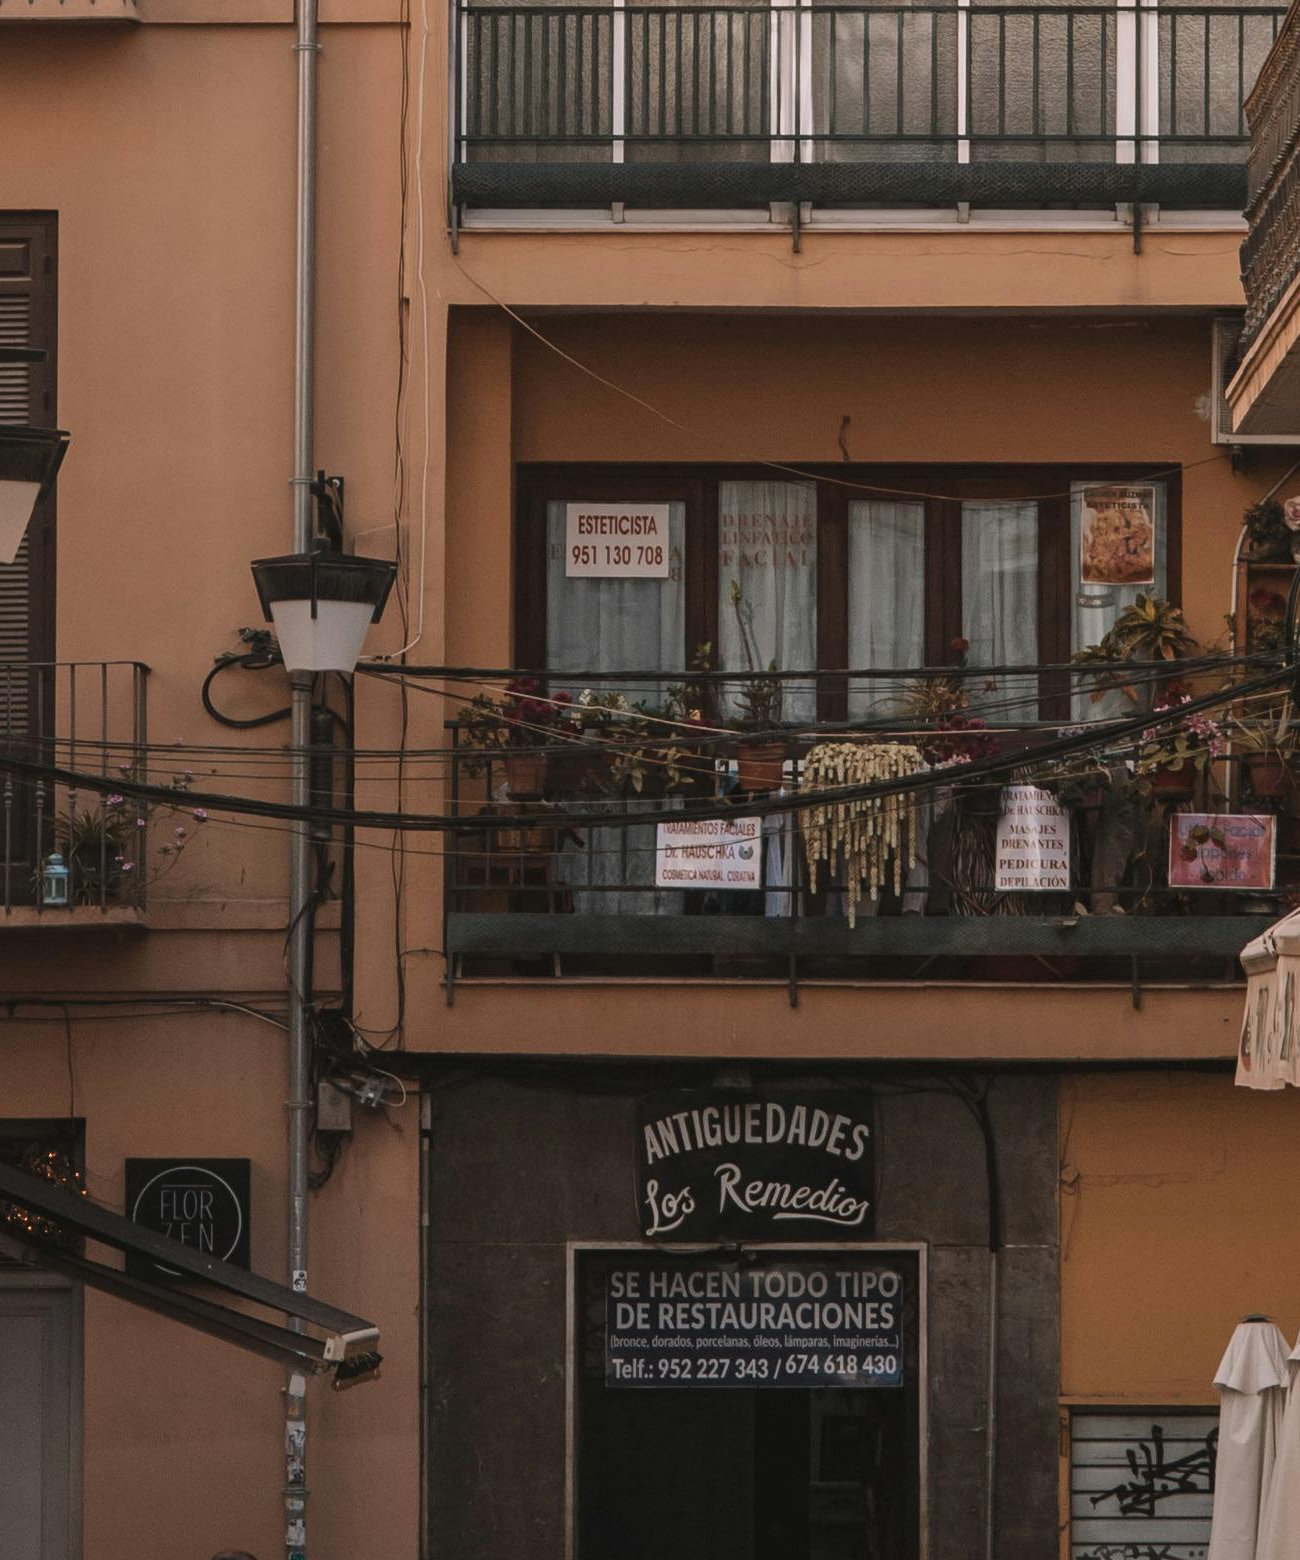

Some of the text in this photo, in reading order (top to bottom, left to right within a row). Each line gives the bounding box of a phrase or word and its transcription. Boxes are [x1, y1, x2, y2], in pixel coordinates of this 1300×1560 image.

[578, 514, 657, 535] ESTETICISTA
[572, 545, 597, 565] 951
[605, 545, 631, 565] 130
[637, 545, 663, 565] 708
[721, 549, 814, 567] FACIAL
[1010, 825, 1056, 835] MASAJES
[1002, 839, 1064, 849] DRENANTES
[999, 858, 1067, 870] PEDICURA
[1000, 874, 1067, 887] DEPILACIÓN
[643, 1103, 869, 1165] ANTIGUEDADES
[160, 1189, 214, 1220] FLOR
[644, 1162, 870, 1237] Los Remedios
[611, 1271, 899, 1299] SE HACEN TODO TIPO
[616, 1303, 894, 1329] DE RESTAURACIONES
[652, 1334, 693, 1349] dorados,
[612, 1359, 653, 1379] Telf.:
[659, 1359, 692, 1379] 952
[697, 1359, 729, 1379] 227
[735, 1359, 769, 1379] 343
[785, 1355, 819, 1375] 674
[824, 1355, 858, 1375] 618
[863, 1355, 897, 1375] 430
